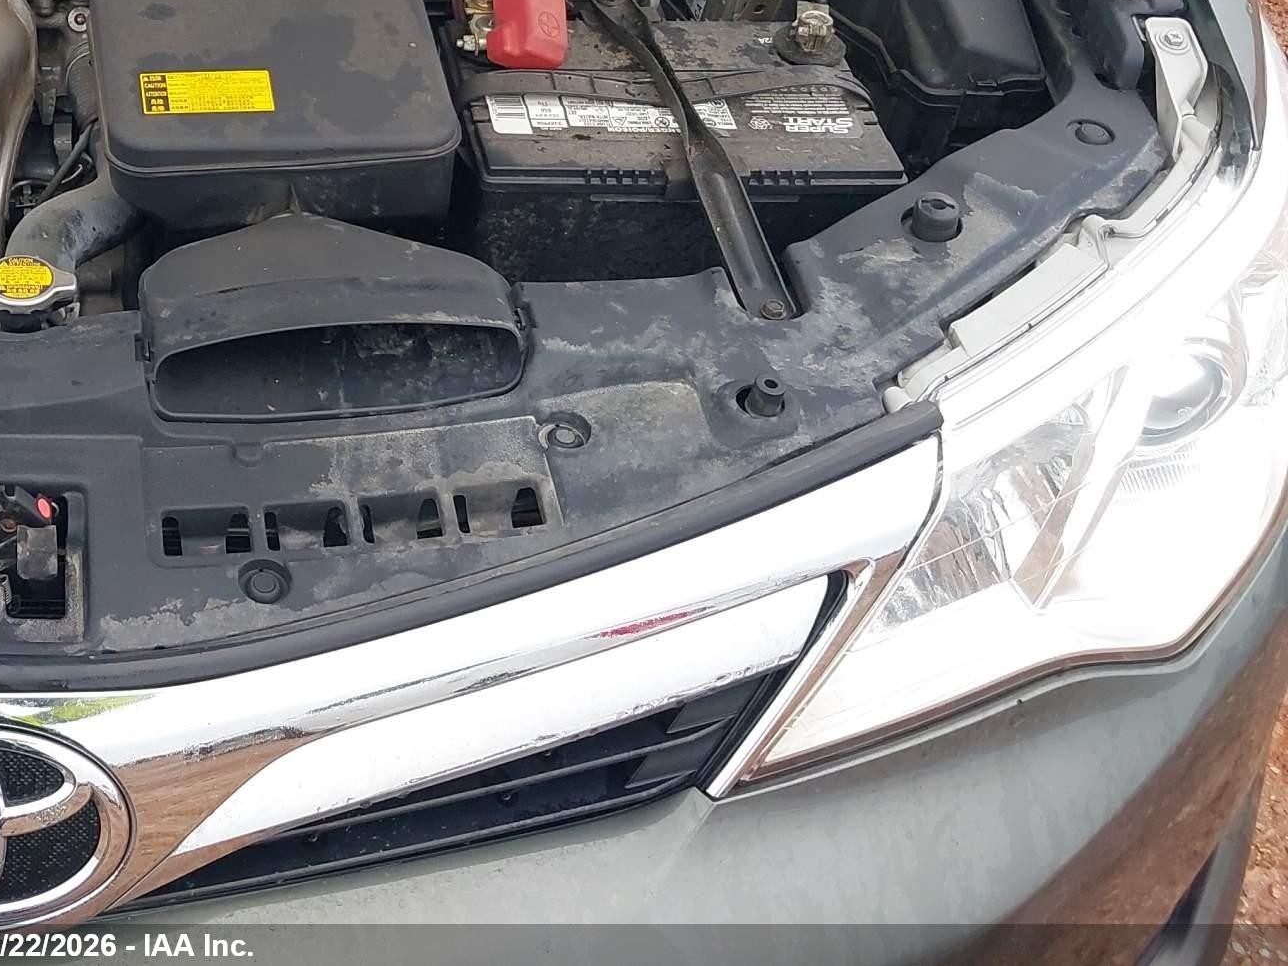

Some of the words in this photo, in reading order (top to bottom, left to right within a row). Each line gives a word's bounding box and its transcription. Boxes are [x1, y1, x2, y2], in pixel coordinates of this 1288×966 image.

[784, 117, 853, 126] START
[608, 126, 682, 134] ANGER/POISON
[786, 125, 849, 134] SUPER
